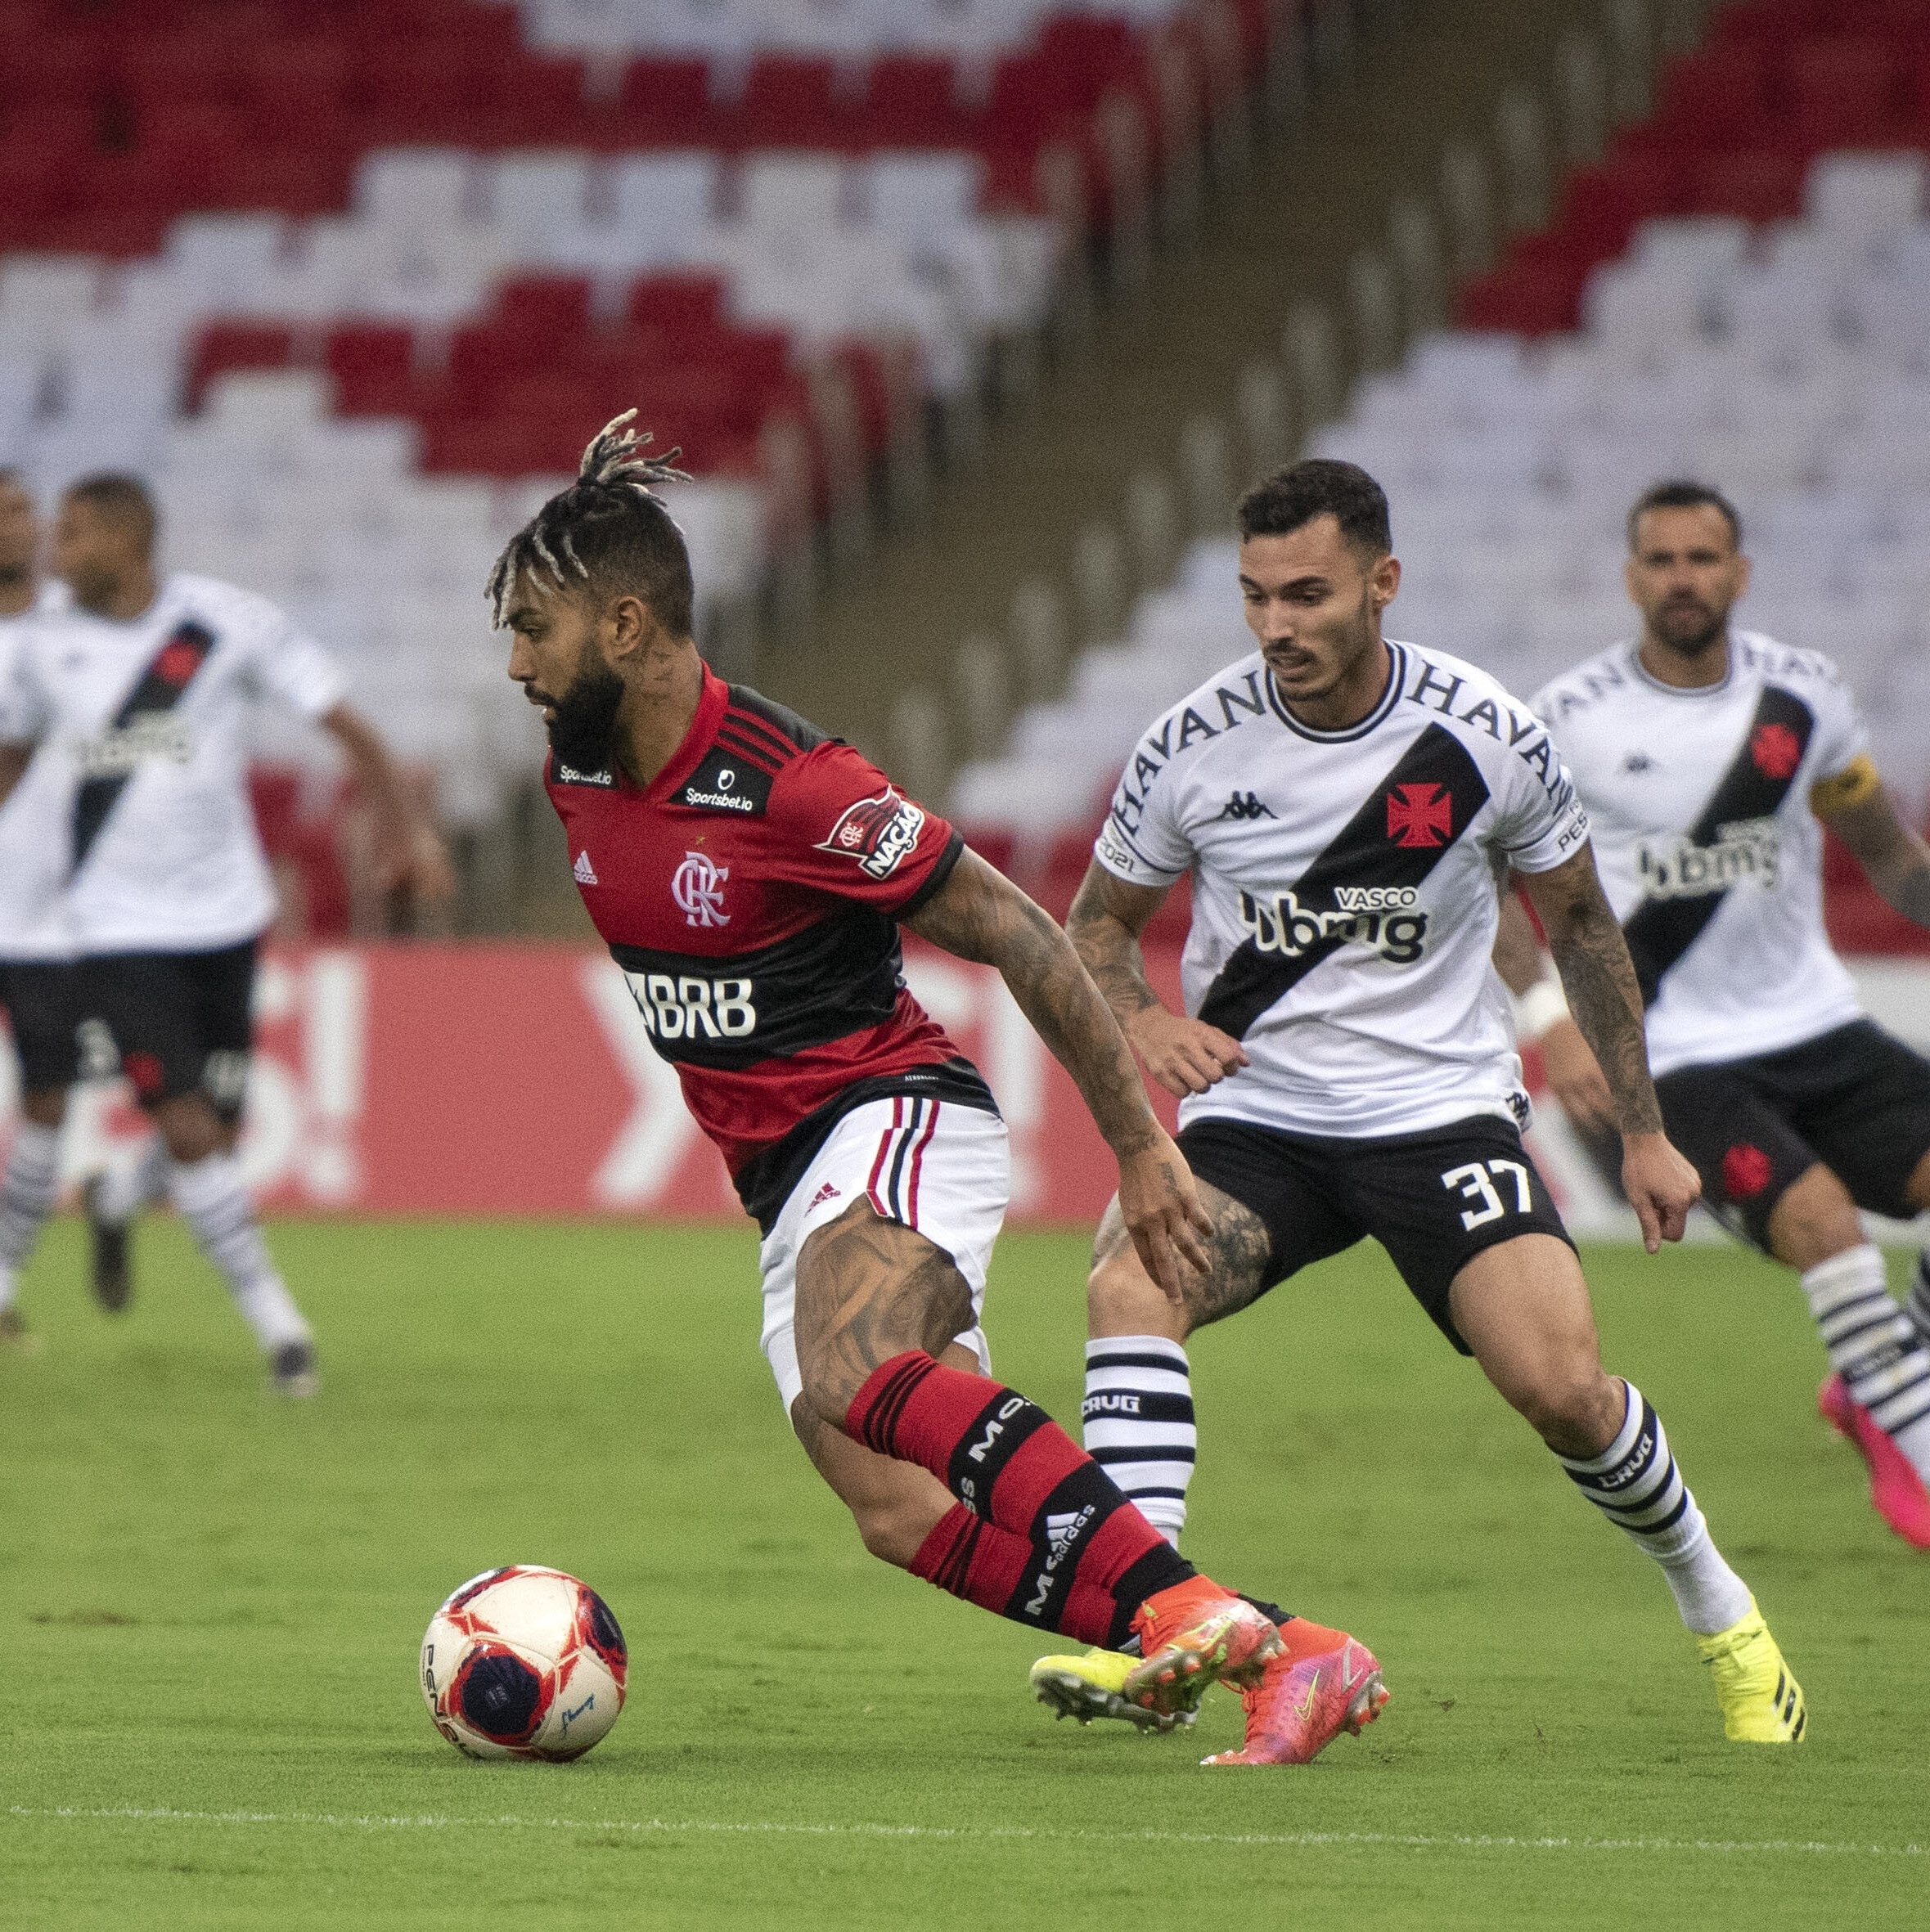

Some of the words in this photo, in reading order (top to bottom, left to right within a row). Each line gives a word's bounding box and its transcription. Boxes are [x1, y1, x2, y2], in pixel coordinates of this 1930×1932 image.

[1113, 670, 1267, 838] HAVAN
[686, 788, 753, 811] Sportsbet.io
[866, 803, 921, 875] NAÇÃO
[1097, 835, 1135, 873] 2021
[1558, 811, 1587, 851] PES
[1337, 889, 1418, 908] VASCO
[647, 973, 757, 1039] BRB
[1441, 1158, 1532, 1232] 37
[1055, 1504, 1095, 1561] adidas
